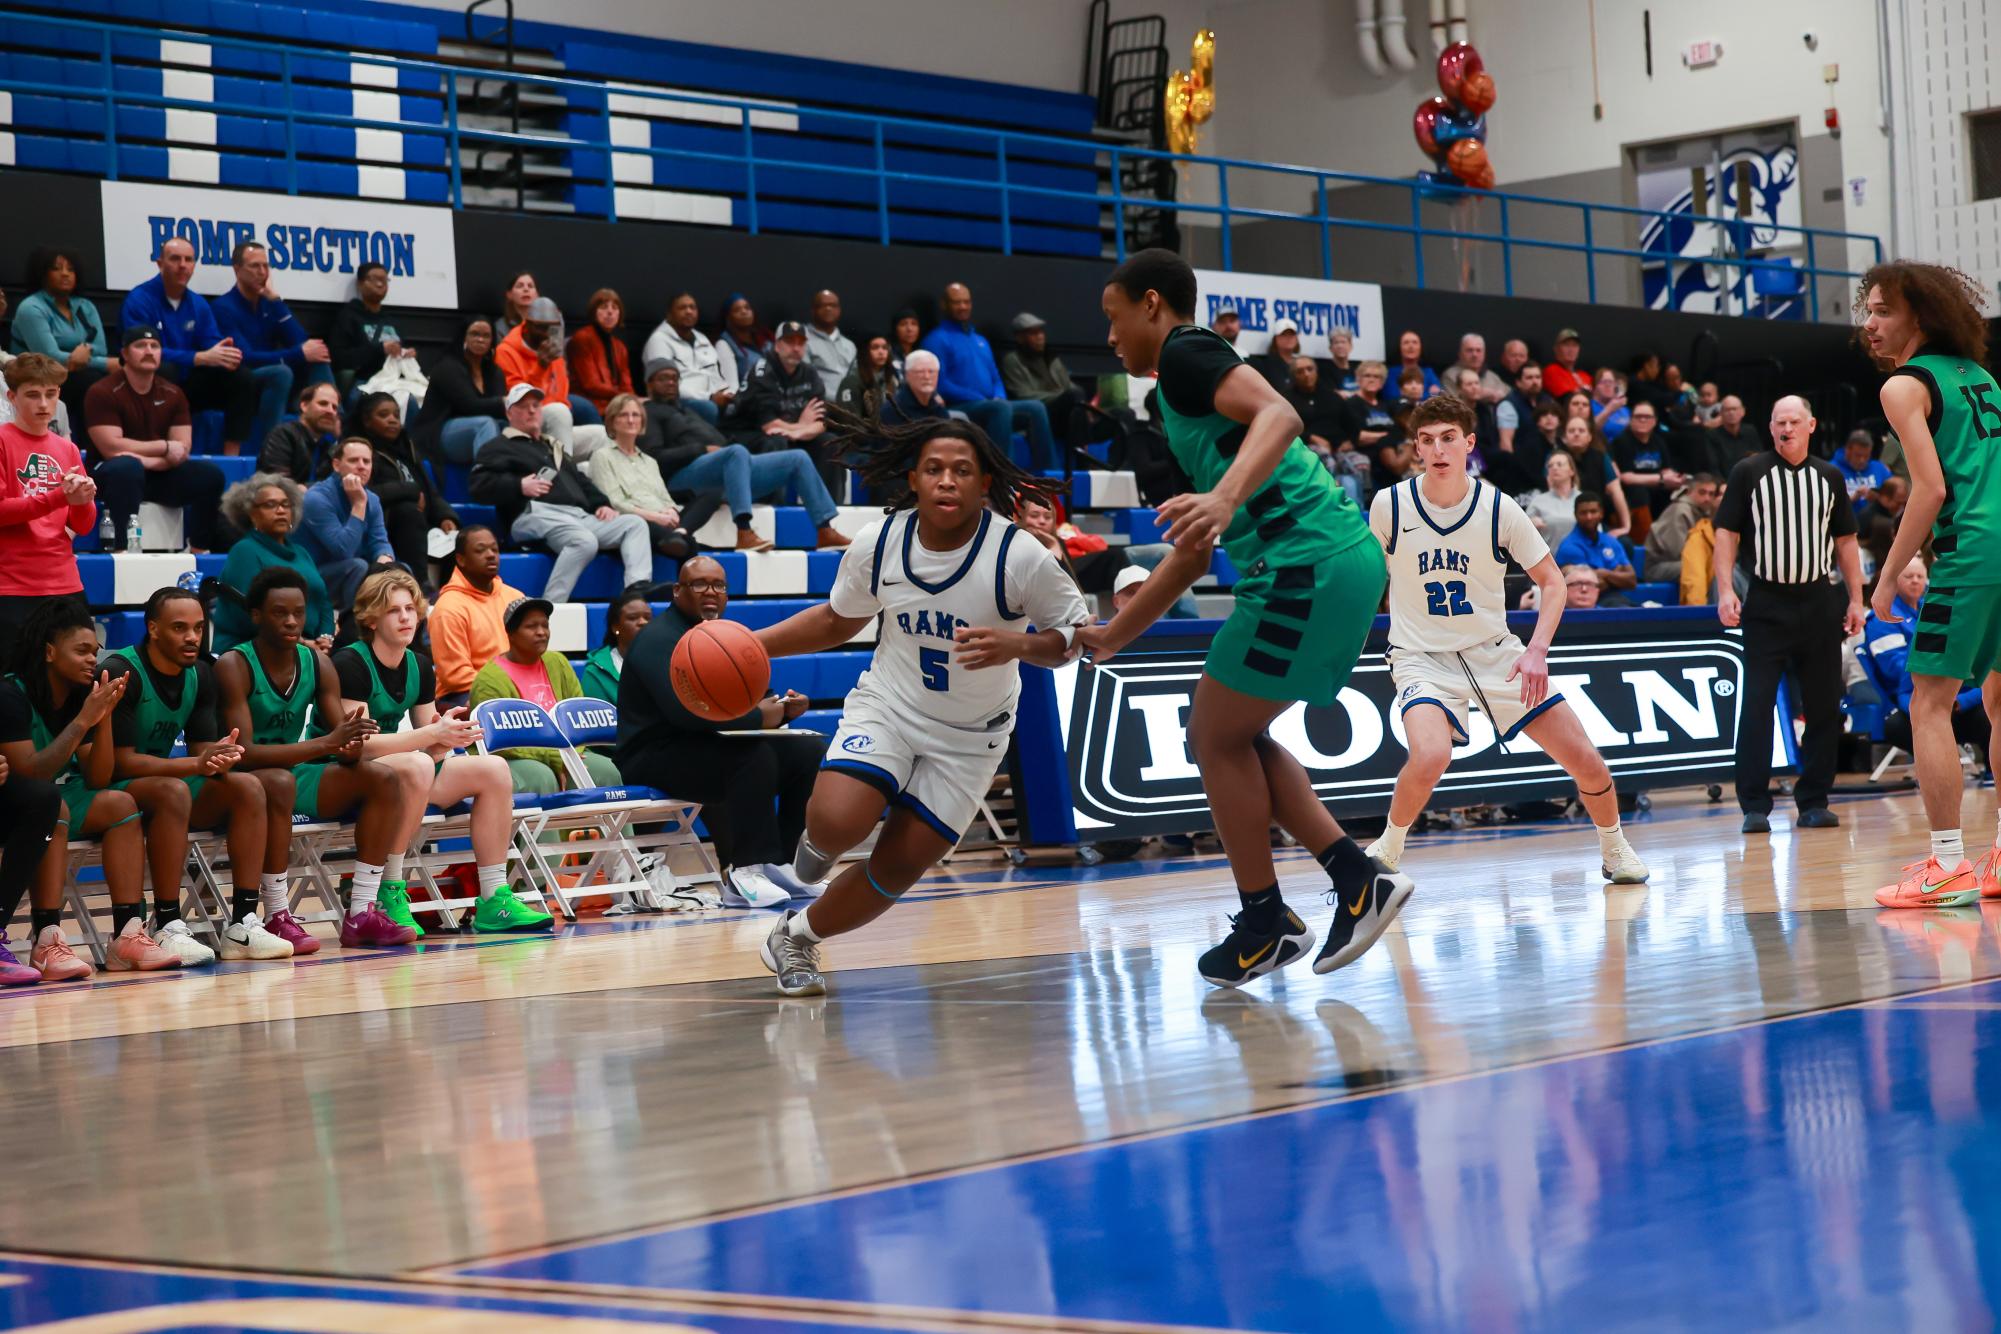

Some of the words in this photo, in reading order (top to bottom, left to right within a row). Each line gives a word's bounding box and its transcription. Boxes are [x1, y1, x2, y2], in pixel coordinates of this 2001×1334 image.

[267, 223, 415, 277] SECTION
[1274, 299, 1359, 338] SECTION
[1959, 383, 2001, 440] 15
[1418, 548, 1469, 575] RAMS
[1424, 581, 1474, 616] 22
[919, 646, 949, 692] 5
[488, 709, 543, 730] LADUE
[567, 709, 617, 729] LADUE
[604, 790, 627, 800] RAMS
[292, 814, 309, 823] AMS
